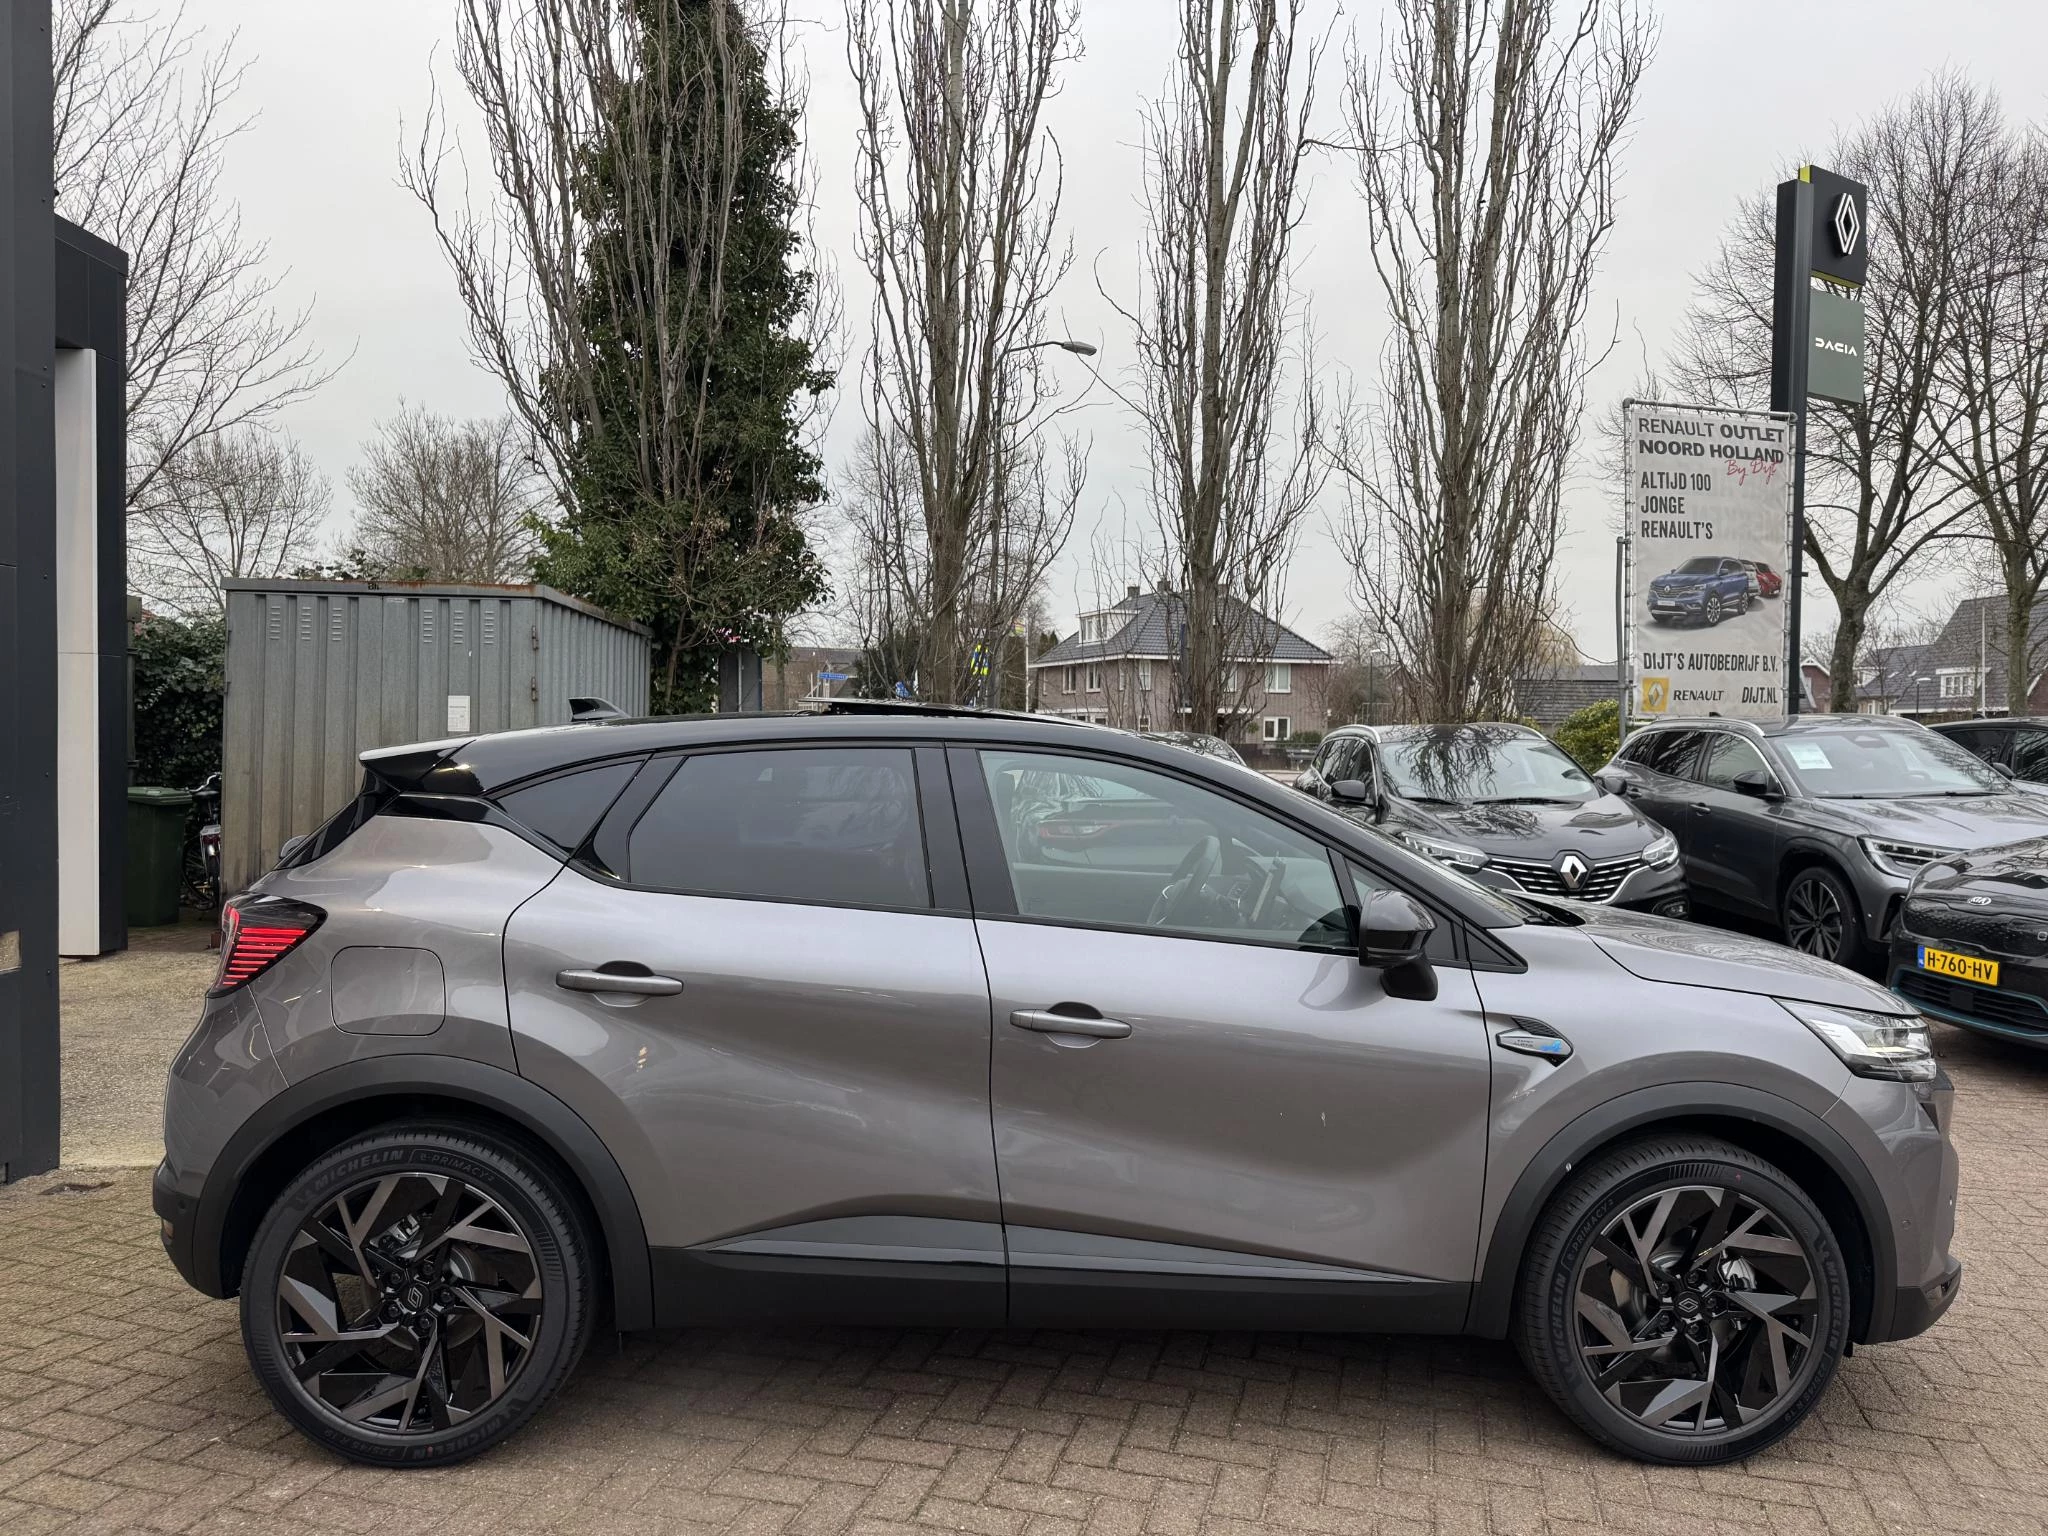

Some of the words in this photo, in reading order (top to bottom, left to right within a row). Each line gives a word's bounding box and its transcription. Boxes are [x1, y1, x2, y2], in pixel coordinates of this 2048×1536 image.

[1815, 337, 1858, 357] DACIA
[1638, 417, 1715, 438] RENAULT
[1720, 424, 1785, 443] OUTLET
[1639, 439, 1705, 457] NOORD
[1710, 444, 1785, 464] HOLLAND
[1640, 471, 1687, 490] ALTIJD
[1690, 473, 1711, 491] 100
[1725, 459, 1748, 486] By
[1640, 495, 1686, 514] JONGE
[1641, 520, 1713, 540] RENAULT'S
[1643, 652, 1685, 670] DIJT'S
[1688, 653, 1760, 672] AUTOBEDRIJF
[1762, 655, 1778, 673] B.V.
[1673, 689, 1725, 701] RENAULT
[1741, 686, 1778, 704] DIJT.NL
[1968, 897, 1991, 905] KIA
[1927, 951, 1993, 980] H-760-HV
[311, 1149, 403, 1192] MICHELIN
[1824, 1261, 1842, 1349] MICHELIN
[1551, 1272, 1569, 1364] MICHELIN
